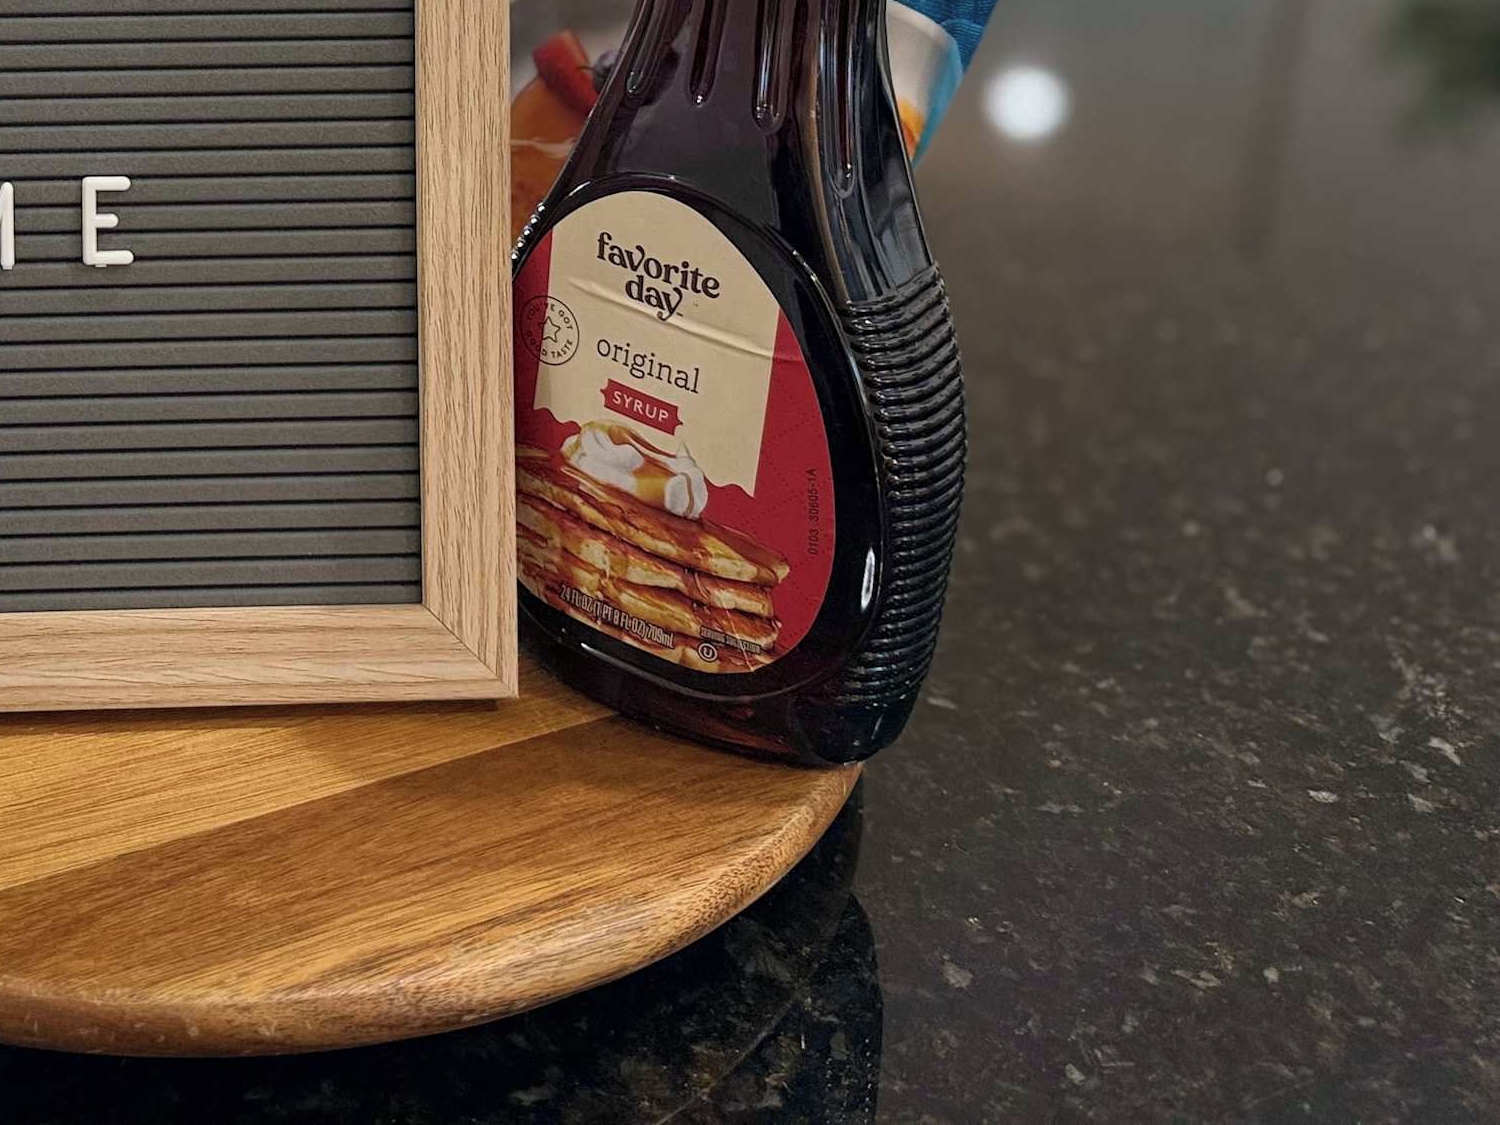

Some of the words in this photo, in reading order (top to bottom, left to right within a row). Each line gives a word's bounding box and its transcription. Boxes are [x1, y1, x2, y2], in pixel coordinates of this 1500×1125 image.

[597, 232, 720, 299] favorite
[625, 275, 683, 321] day
[597, 339, 699, 394] original
[612, 391, 669, 423] SYRUP
